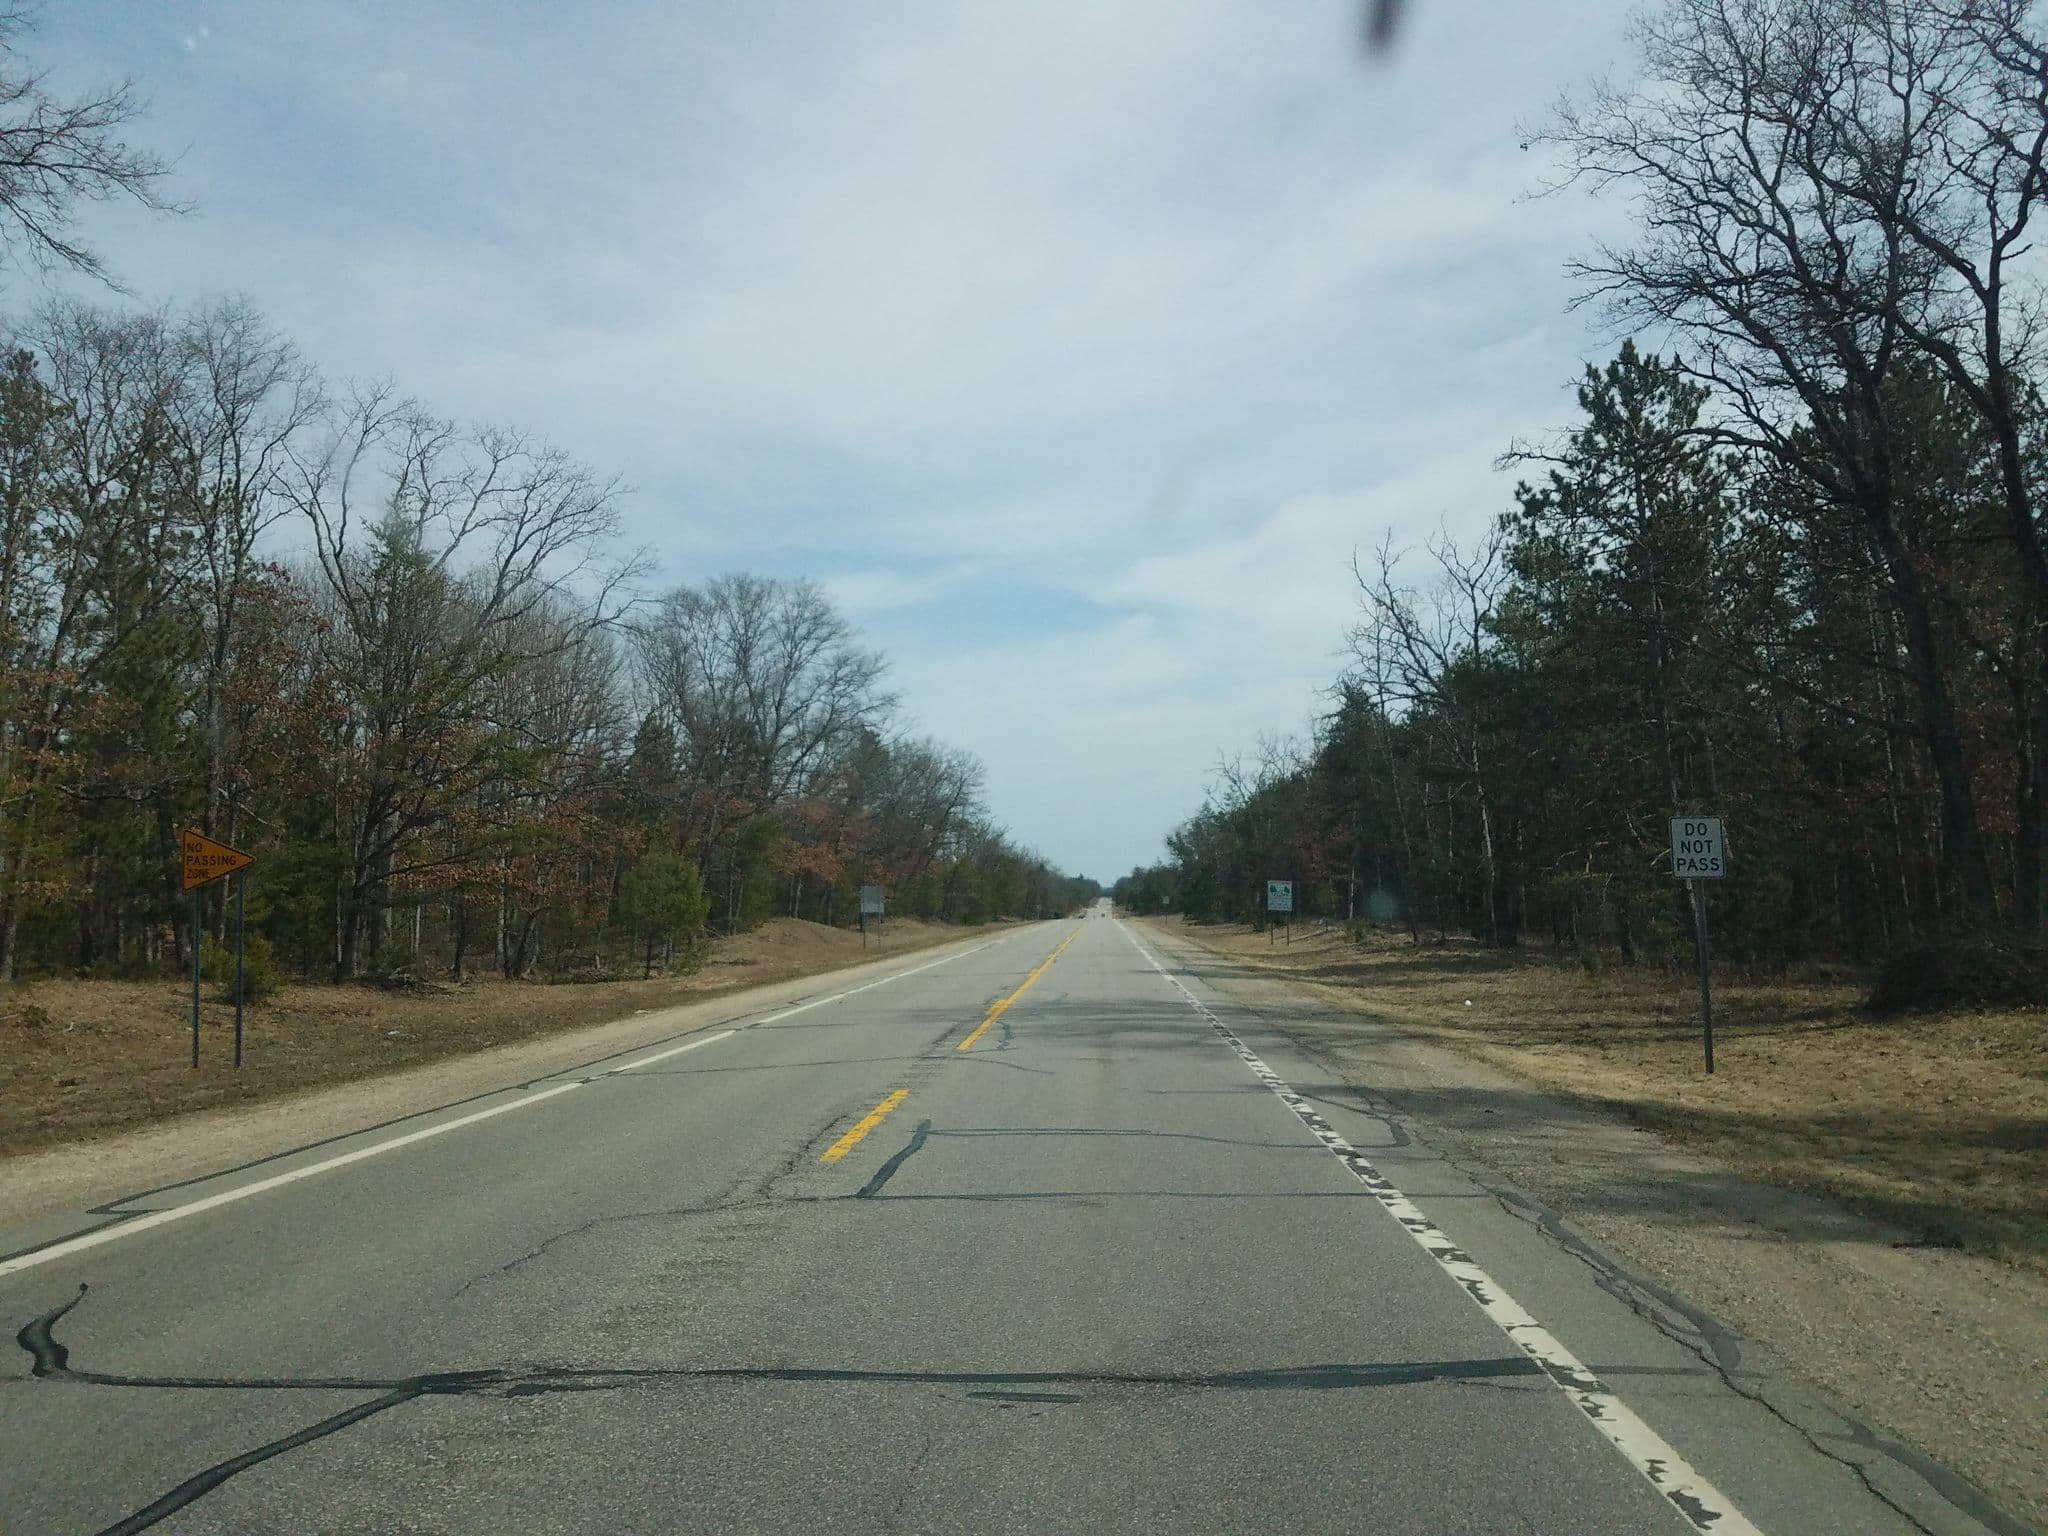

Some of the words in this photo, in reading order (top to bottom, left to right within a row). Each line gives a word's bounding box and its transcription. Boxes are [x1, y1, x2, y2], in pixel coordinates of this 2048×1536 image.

[1684, 822, 1708, 837] DO
[186, 842, 203, 853] NO
[1680, 839, 1713, 854] NOT
[185, 854, 237, 866] PASSING
[1676, 857, 1720, 872] PASS
